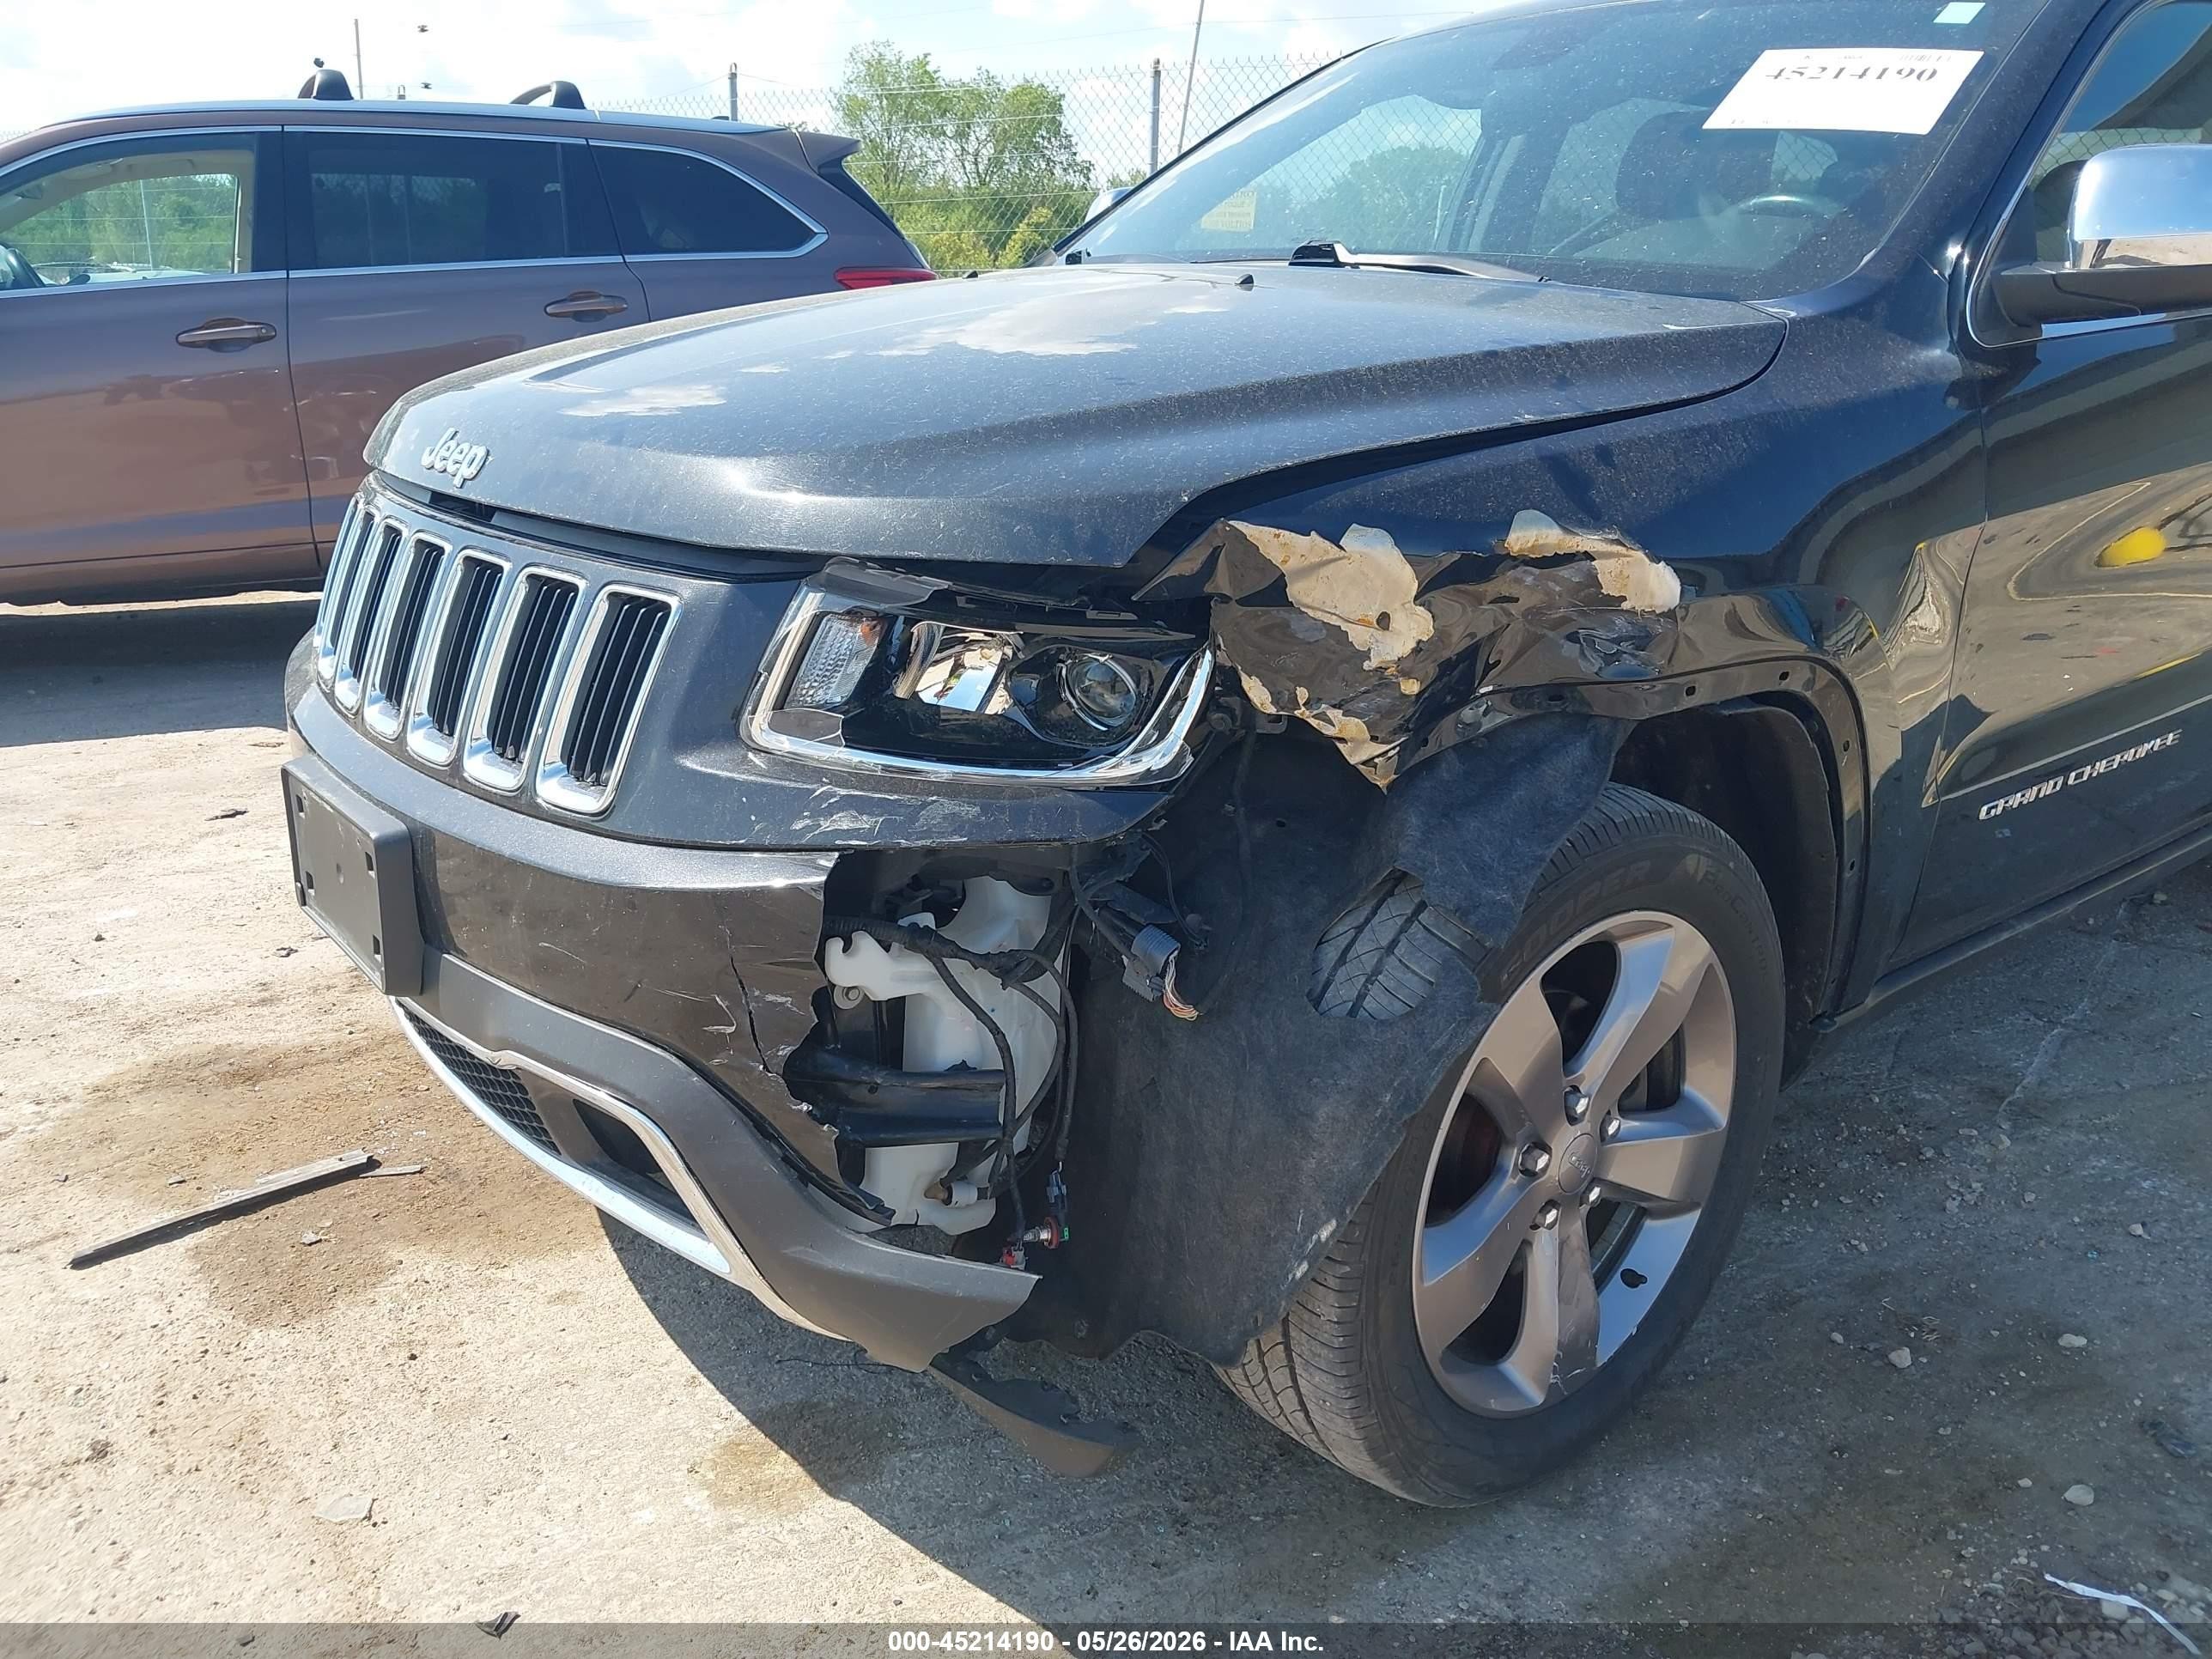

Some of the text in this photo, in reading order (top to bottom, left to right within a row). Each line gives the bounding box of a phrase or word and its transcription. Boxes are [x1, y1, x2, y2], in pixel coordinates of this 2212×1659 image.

[1765, 66, 1939, 82] 45214190
[422, 428, 489, 489] Jeep
[1978, 728, 2184, 821] GRAND CHEROKEE
